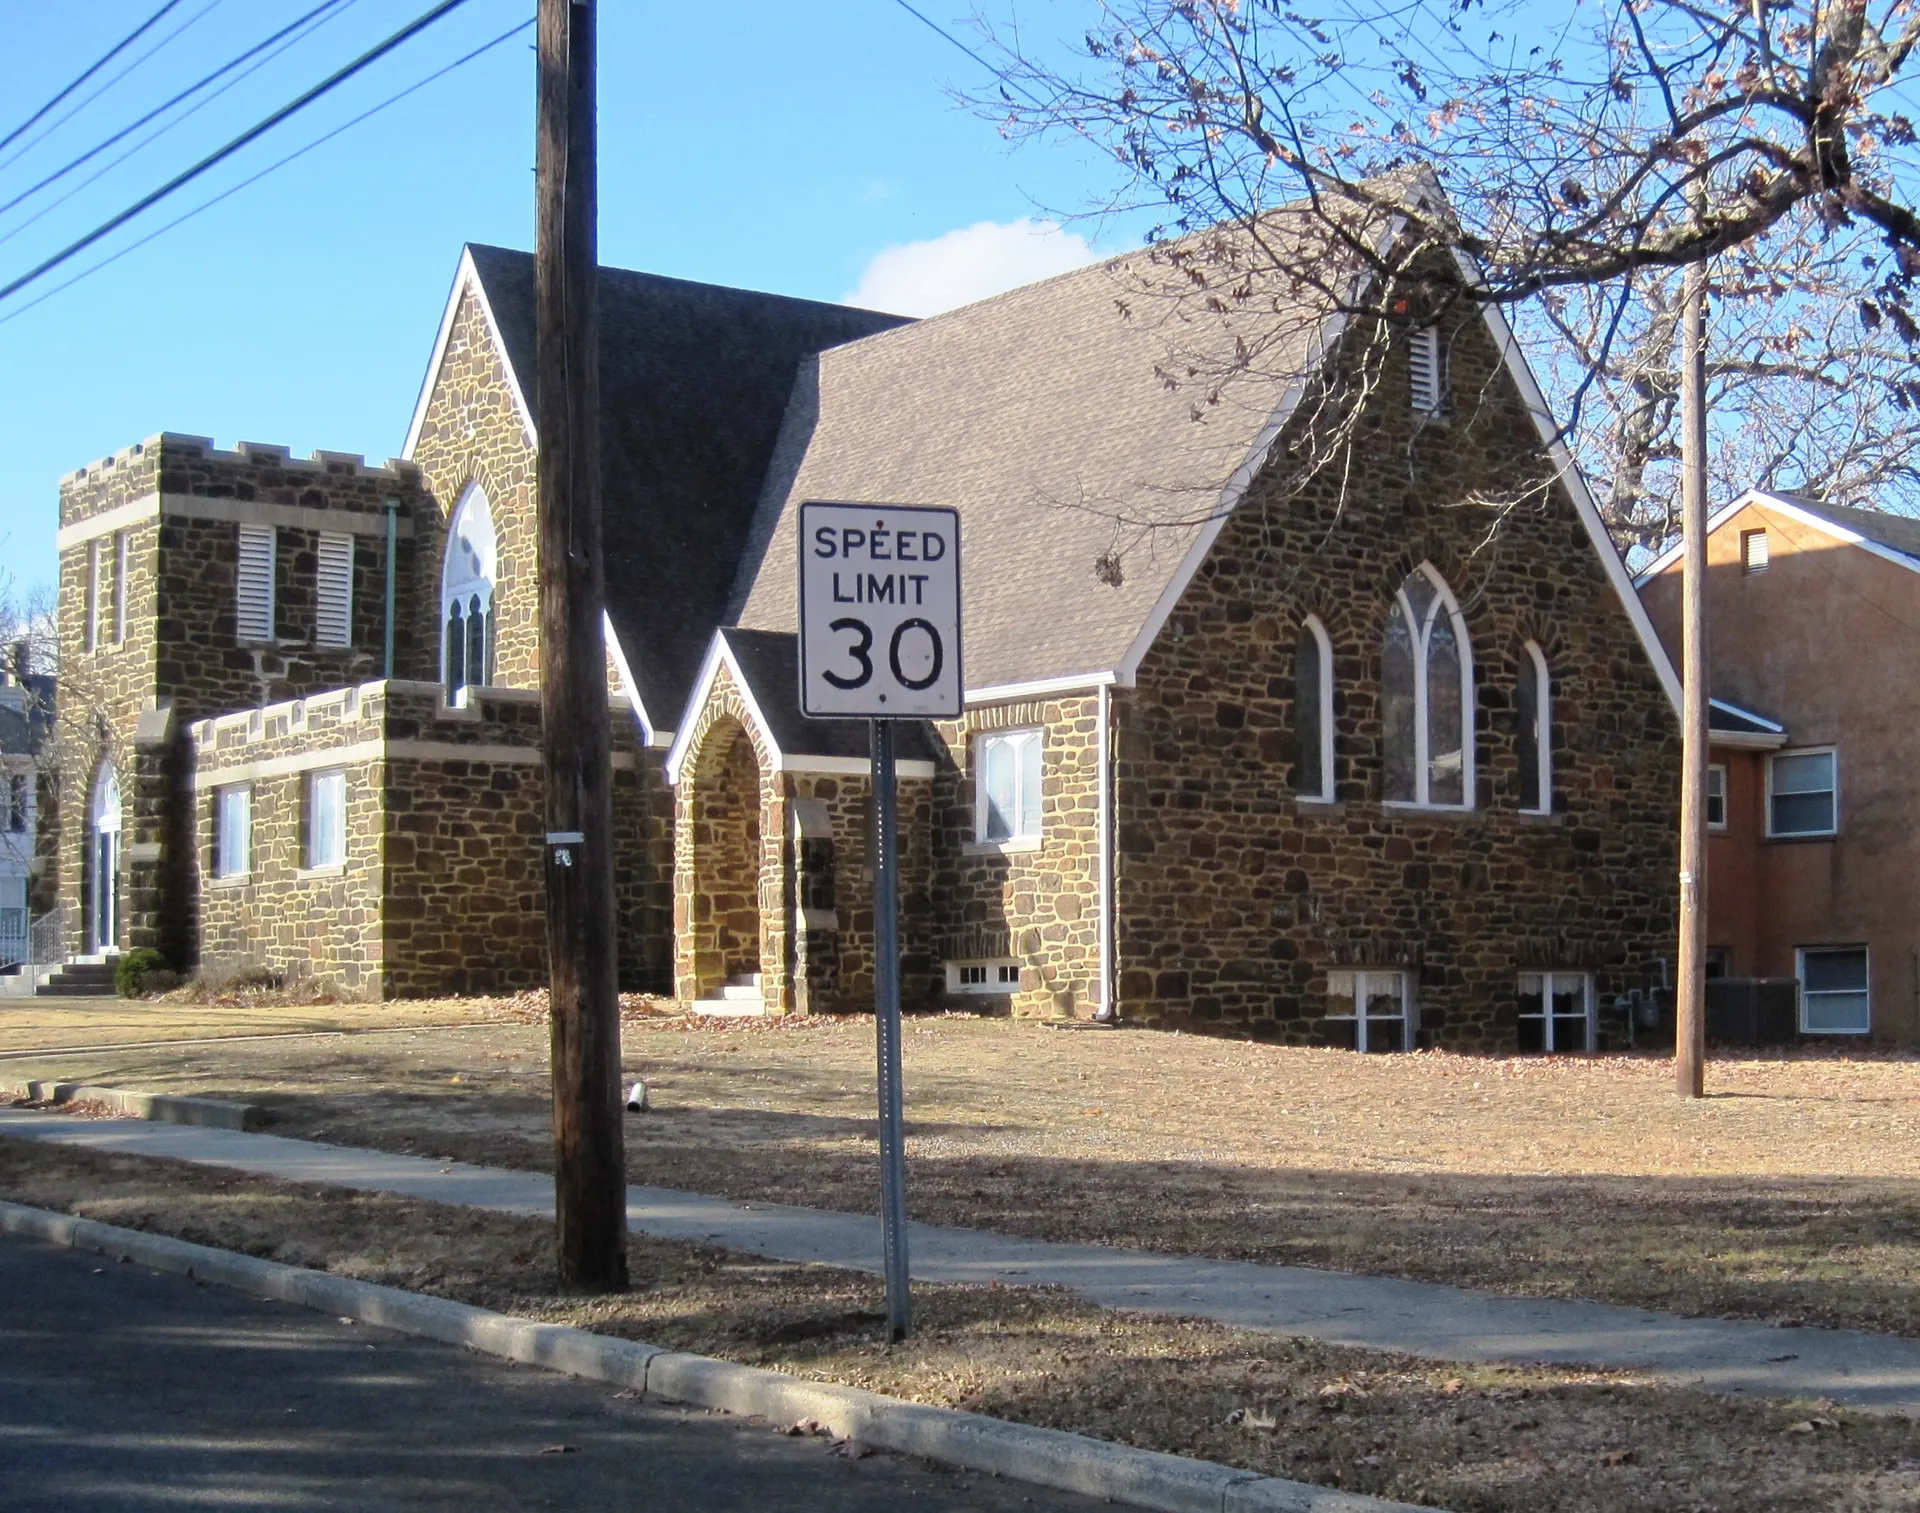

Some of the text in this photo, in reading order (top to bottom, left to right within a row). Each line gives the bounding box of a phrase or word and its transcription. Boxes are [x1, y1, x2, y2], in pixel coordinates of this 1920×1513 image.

[814, 526, 946, 562] SPEED
[832, 572, 930, 605] LIMIT
[821, 617, 944, 691] 30
